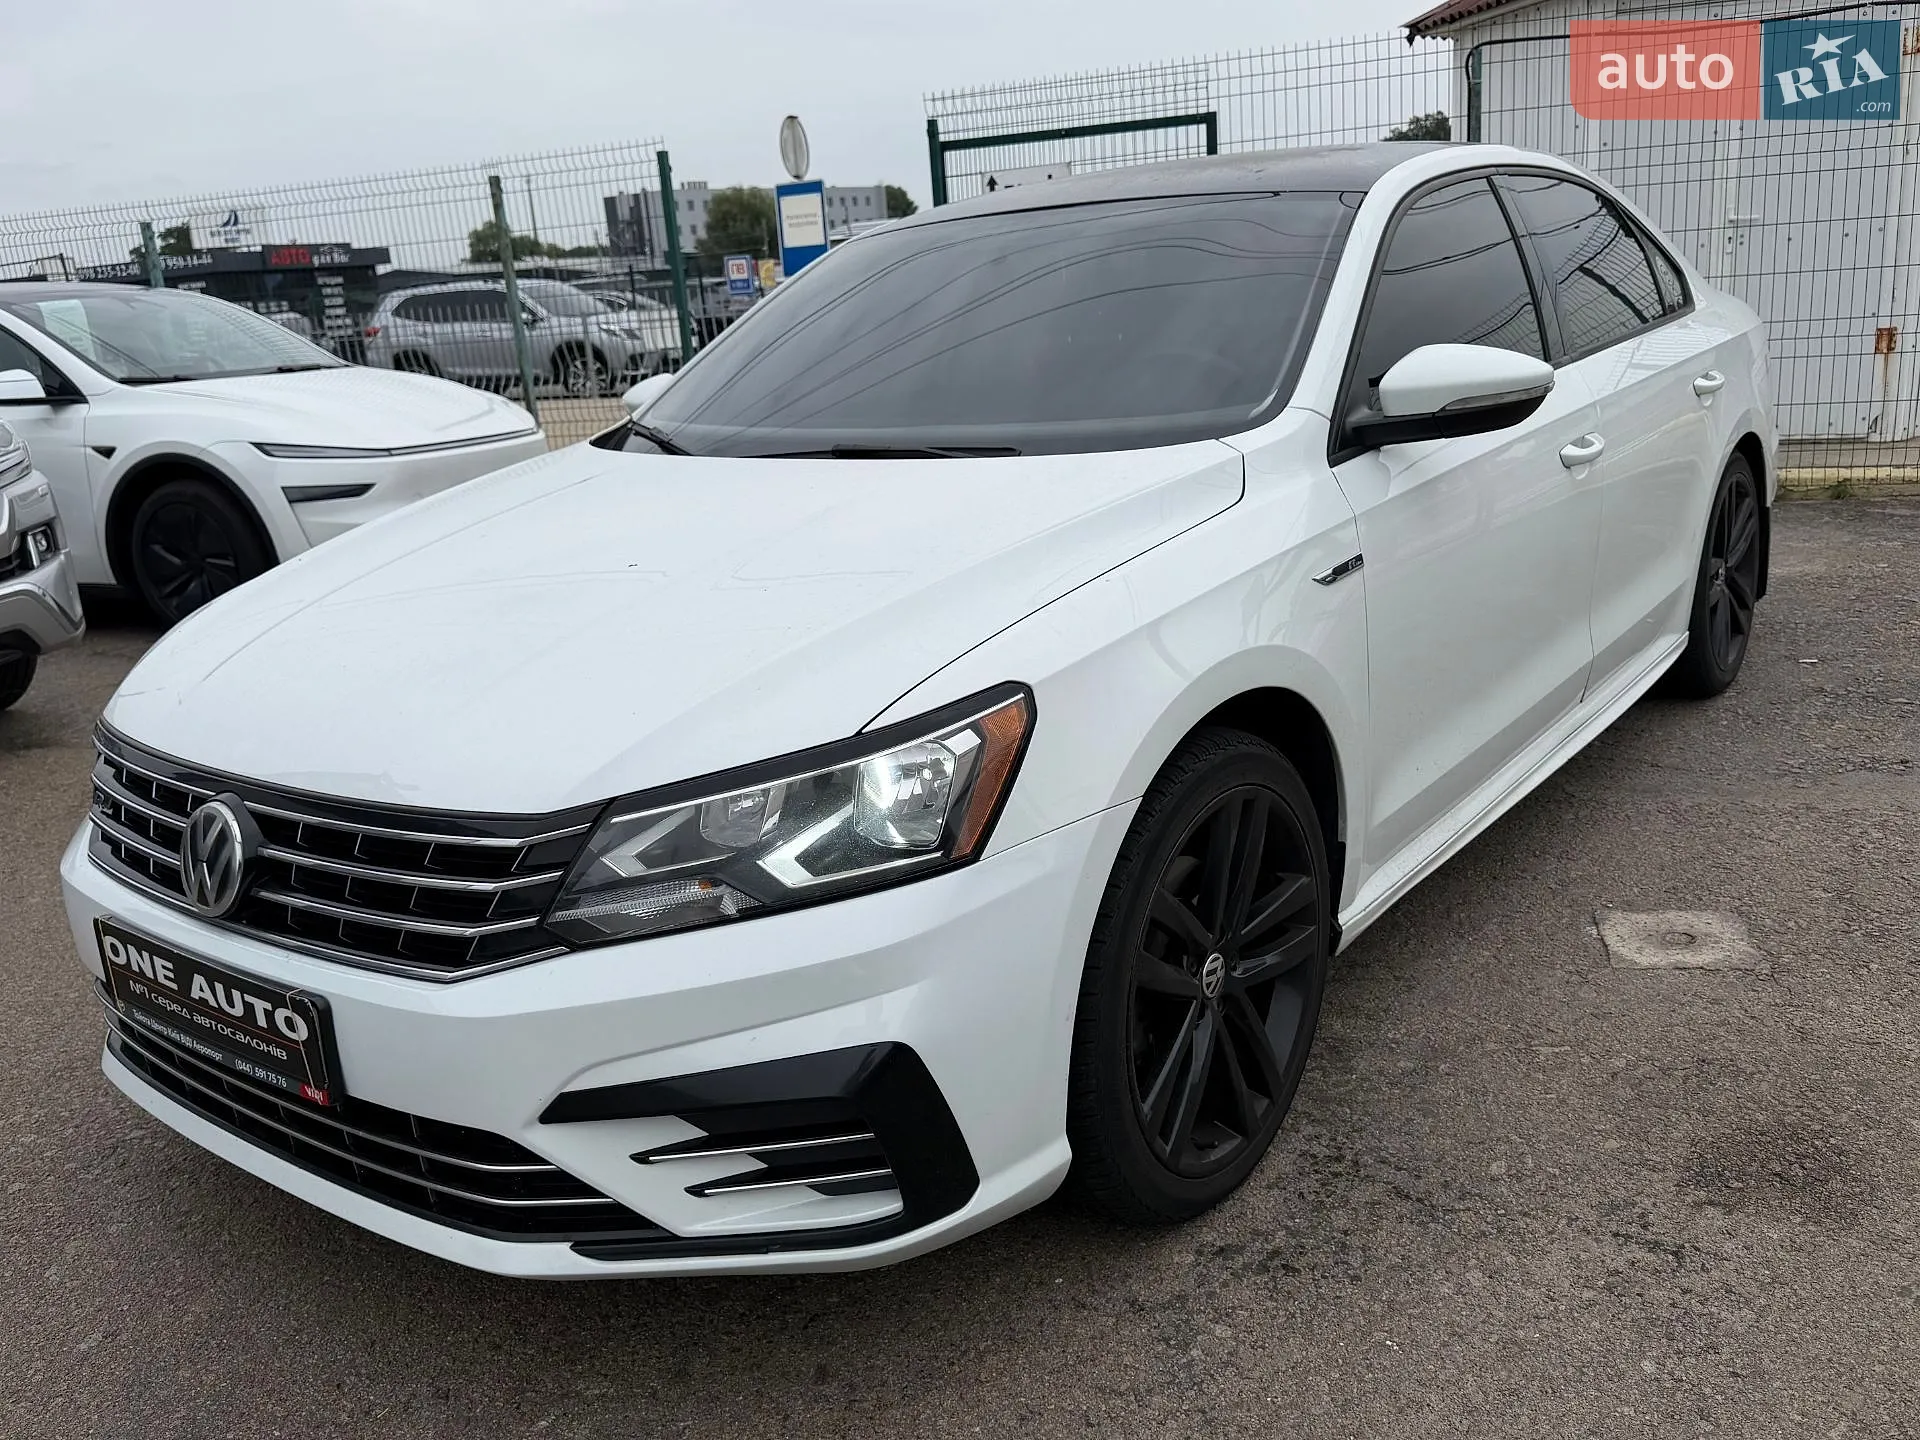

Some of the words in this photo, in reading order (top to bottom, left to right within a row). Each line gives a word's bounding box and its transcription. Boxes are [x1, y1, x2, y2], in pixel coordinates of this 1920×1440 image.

[103, 935, 179, 991] ONE
[190, 972, 309, 1042] AUTO
[151, 992, 191, 1019] серед
[192, 1012, 288, 1060] автосалонів
[234, 1058, 253, 1075] (044)
